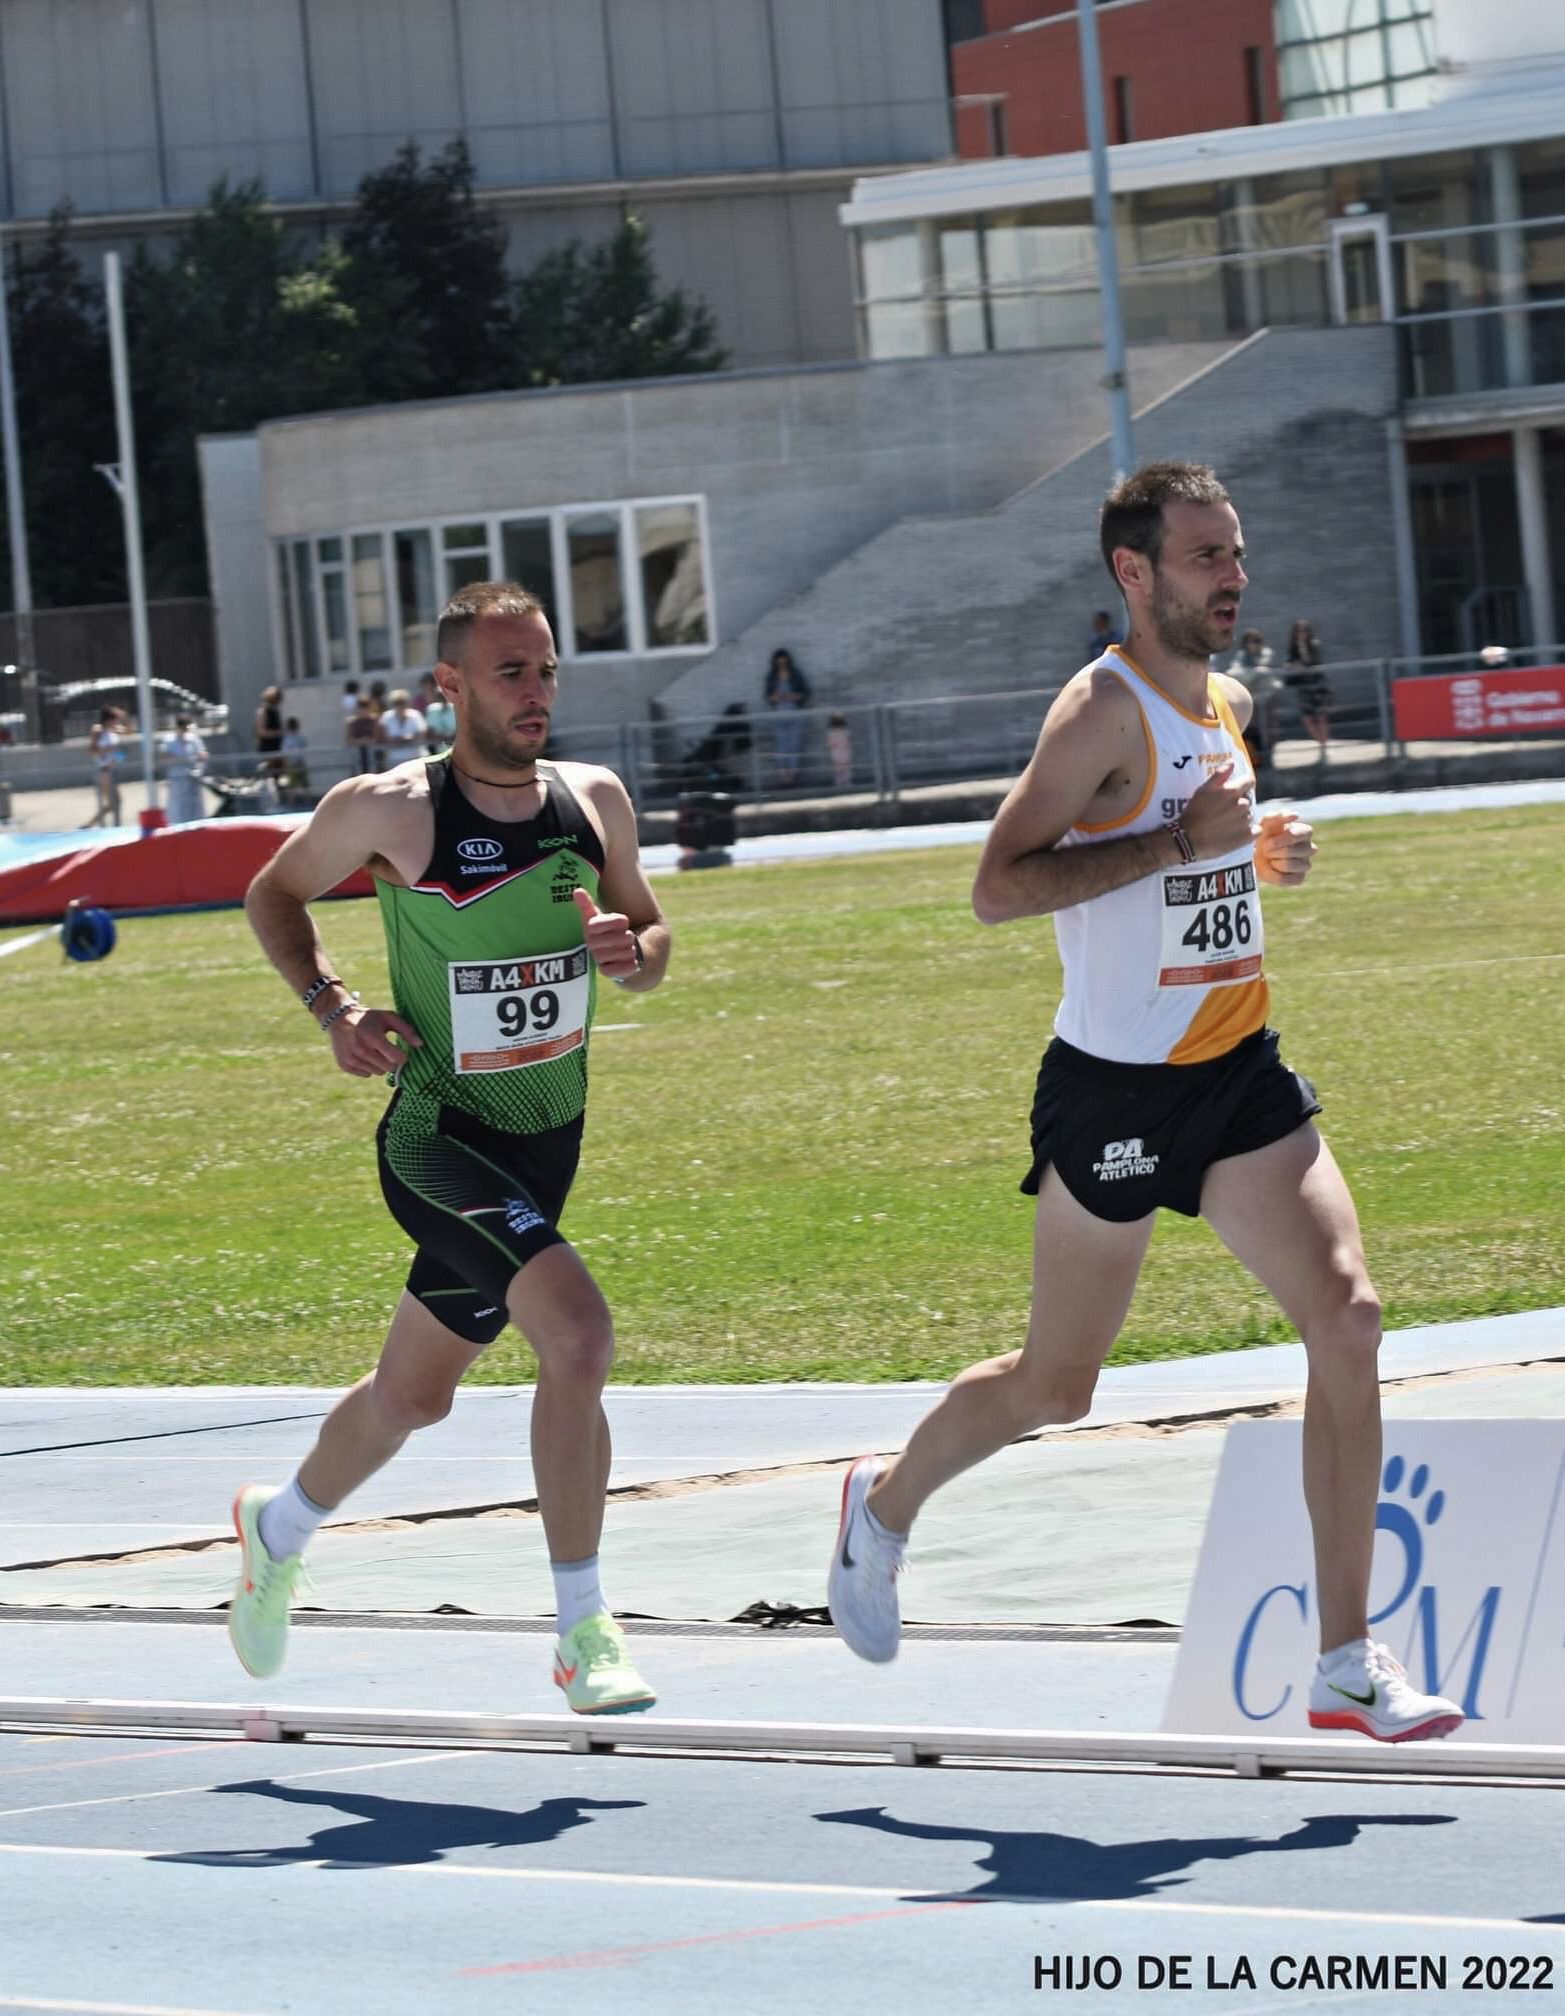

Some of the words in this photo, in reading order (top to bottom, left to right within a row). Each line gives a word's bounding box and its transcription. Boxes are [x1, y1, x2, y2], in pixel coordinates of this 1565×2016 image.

[465, 843, 496, 855] KIA
[1182, 900, 1251, 952] 486
[489, 958, 565, 991] A4XKM
[496, 990, 560, 1037] 99
[1093, 1155, 1160, 1172] PAMPLONA
